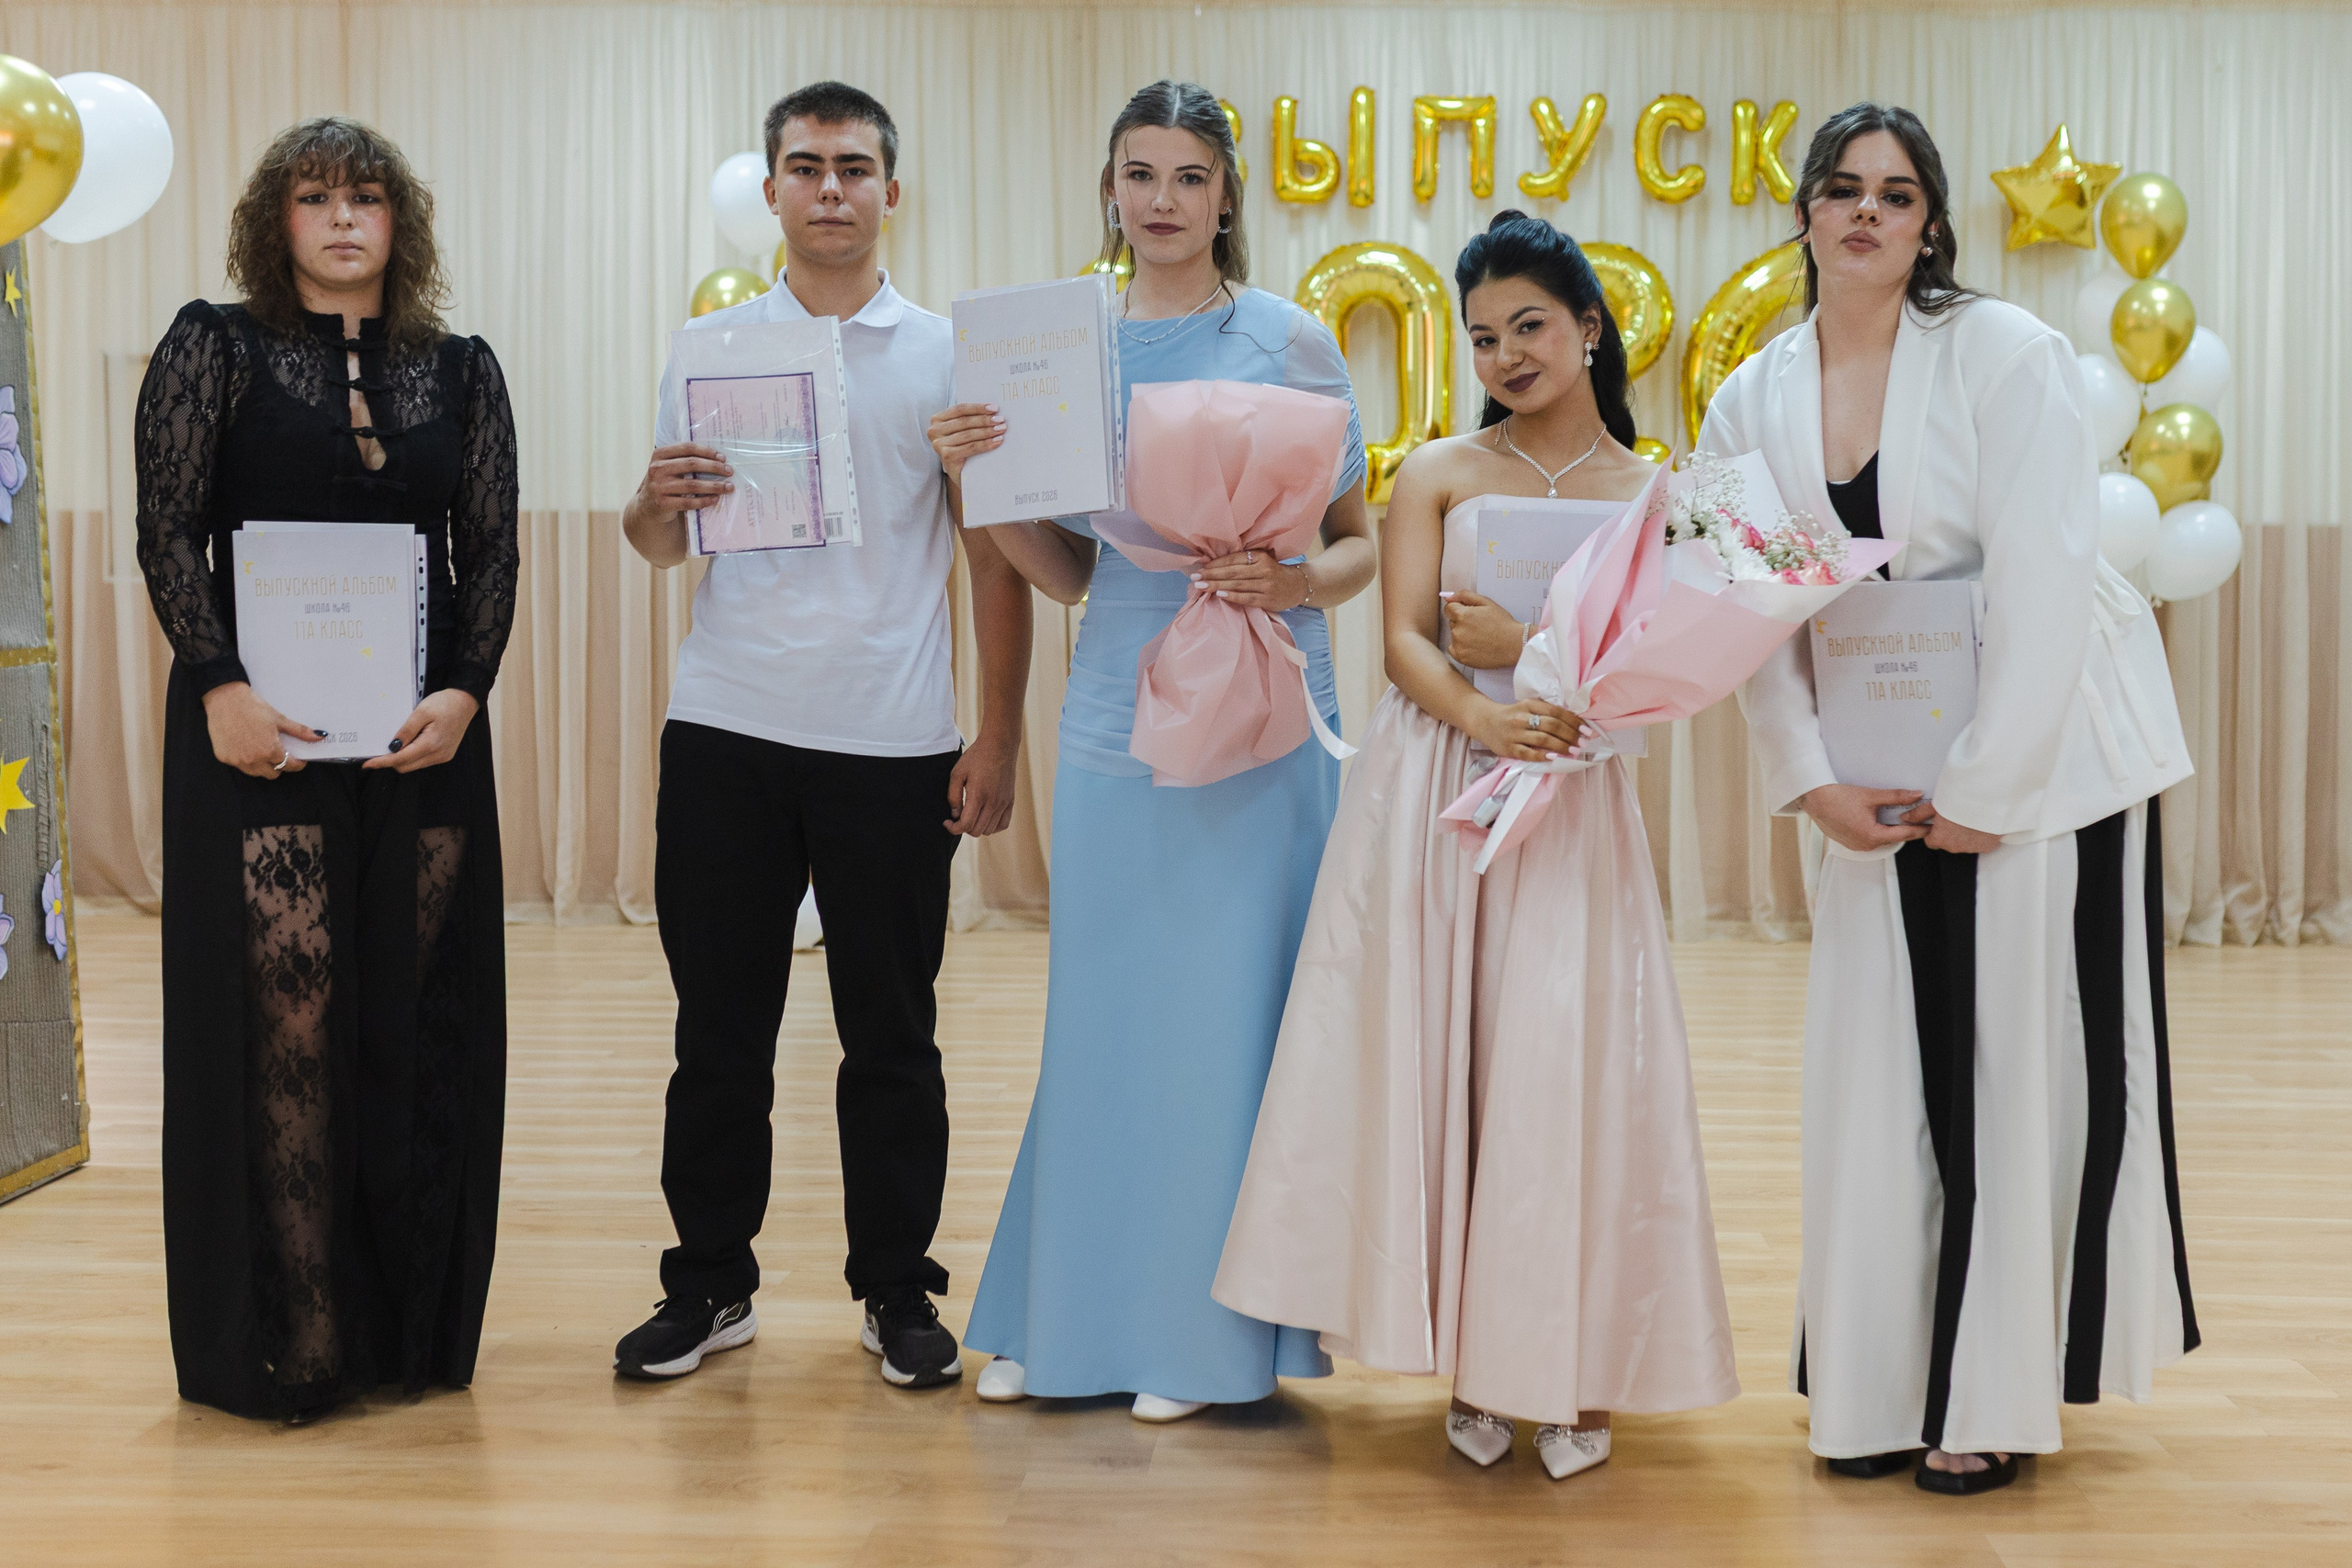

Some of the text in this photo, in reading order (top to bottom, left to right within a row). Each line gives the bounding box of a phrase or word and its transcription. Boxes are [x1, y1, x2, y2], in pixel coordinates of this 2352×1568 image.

[968, 327, 1089, 364] ВЫПУСКНОЙ АЛЬБОМ
[1009, 362, 1032, 376] ШКОЛА
[1001, 376, 1060, 402] 11А КЛАСС
[1014, 491, 1040, 506] ВЫПУСК
[1497, 558, 1566, 581] ВЫПУСКН
[254, 574, 397, 597] ВЫПУСКНОЙ АЛЬБОМ
[304, 603, 331, 615] ШКОЛА
[294, 619, 364, 640] 11А КЛАСС
[1827, 631, 1962, 658] ВЫПУСКНОЙ АЛЬБОМ
[1865, 680, 1932, 702] 11А КЛАСС
